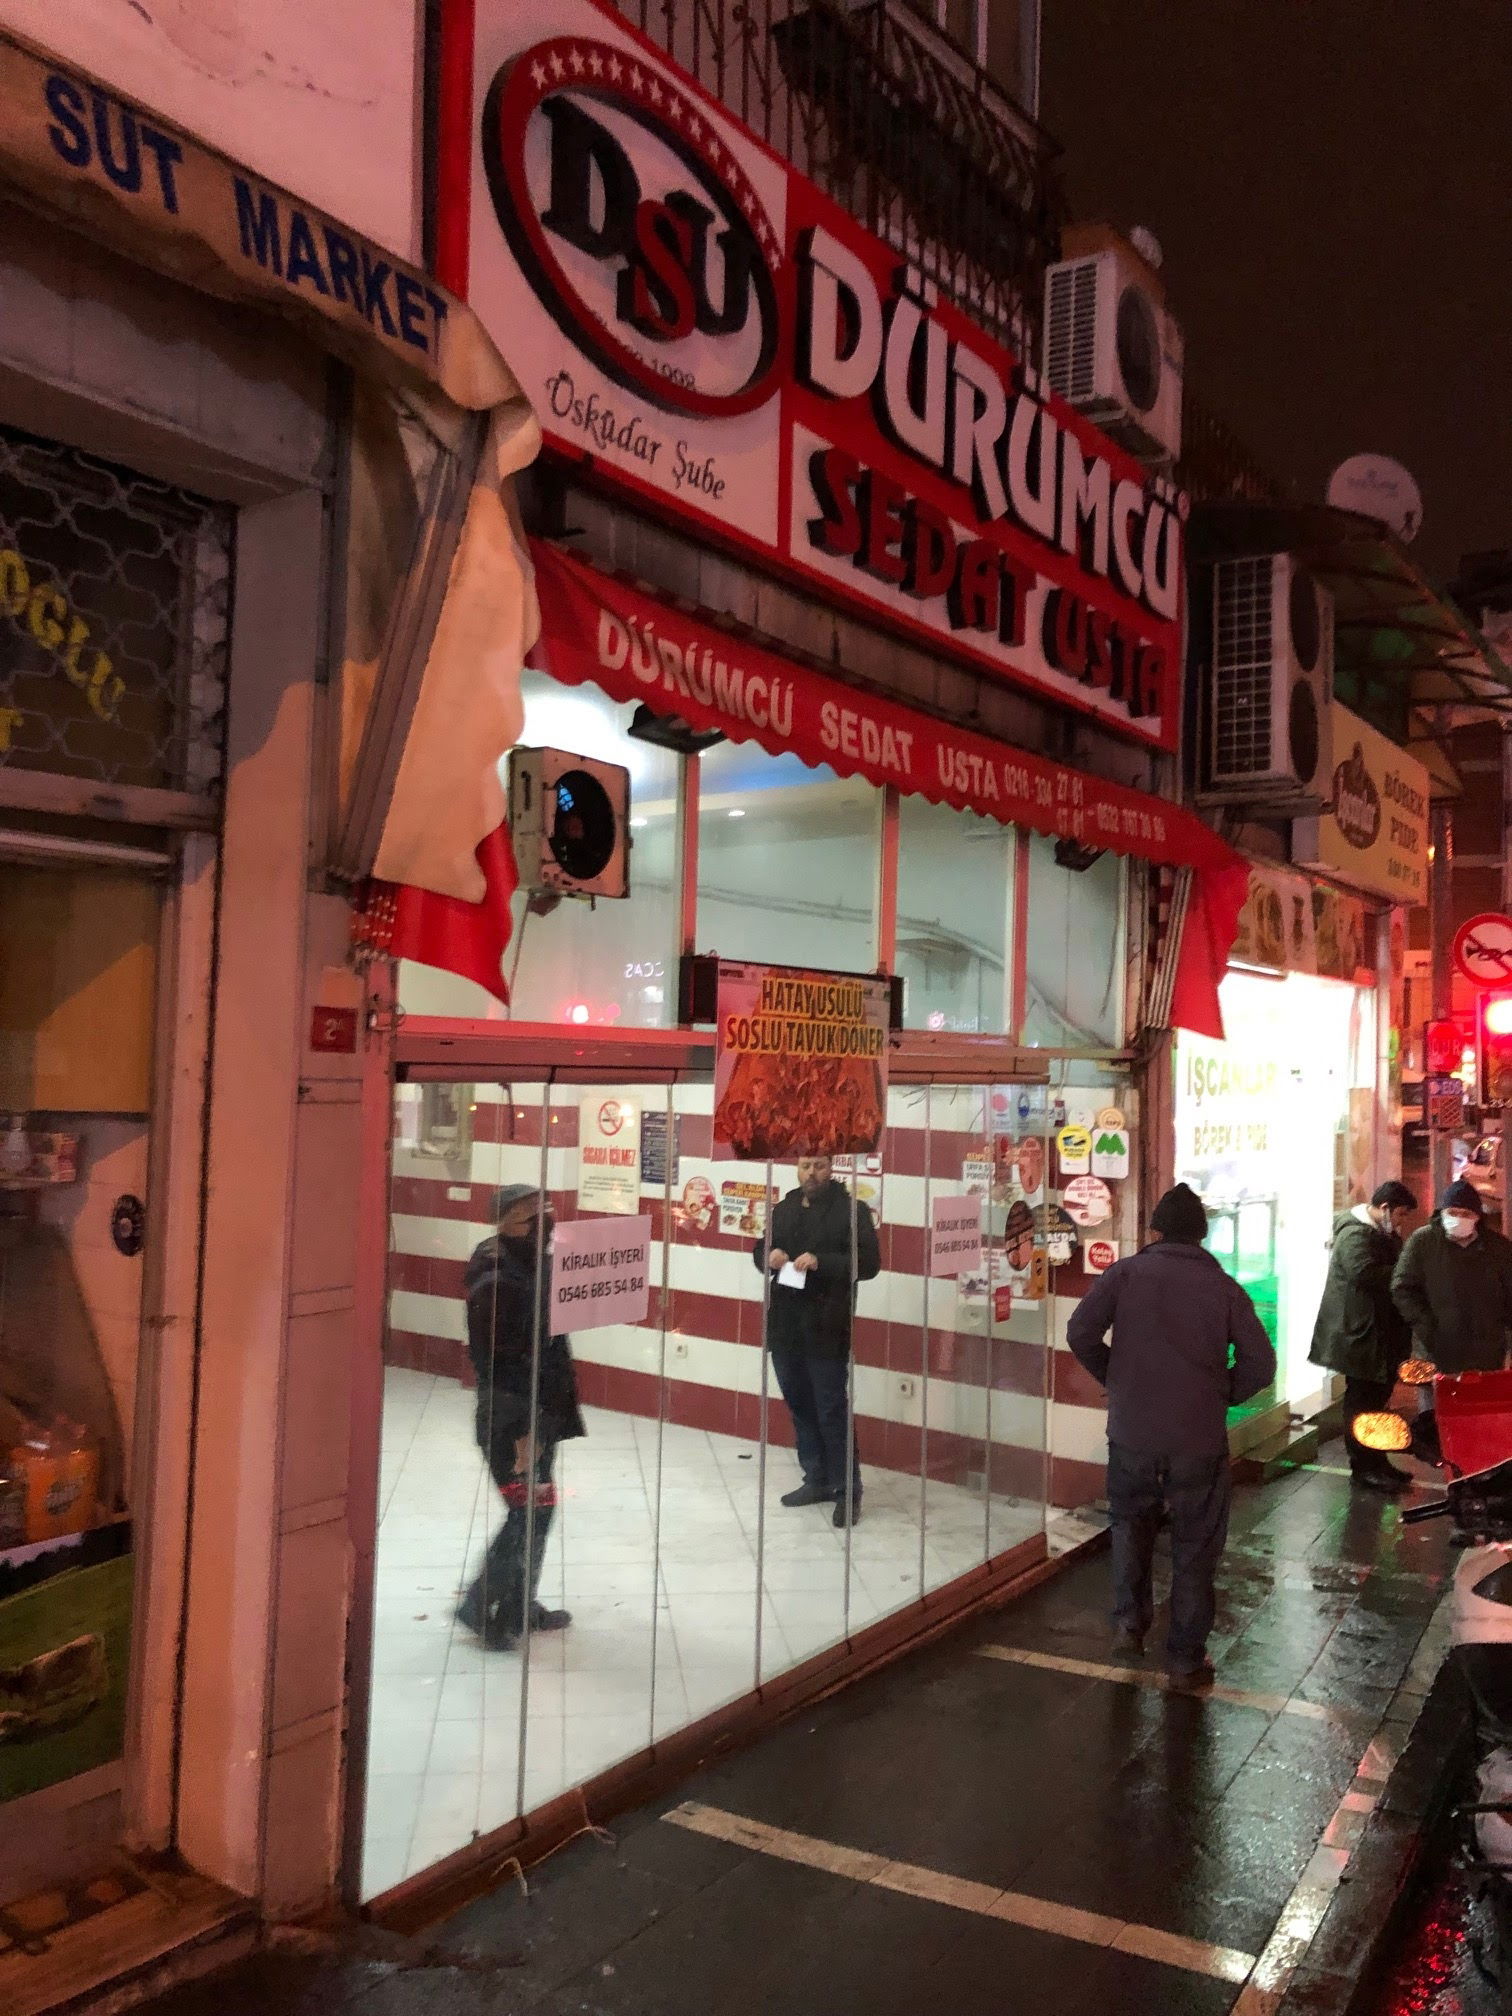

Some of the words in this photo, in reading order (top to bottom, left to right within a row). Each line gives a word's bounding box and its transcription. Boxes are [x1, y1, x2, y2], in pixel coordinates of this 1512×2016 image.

[234, 176, 448, 365] MARKET
[806, 225, 1180, 622] DÜRÜMCÜ
[672, 439, 726, 500] Şube
[808, 447, 1037, 648] SEDAT
[1046, 585, 1166, 719] USTA
[599, 606, 793, 738] DÜRÜMCÜ
[820, 701, 914, 776] SEDAT
[938, 743, 1000, 802] USTA
[761, 978, 814, 1017] HATAY
[817, 982, 863, 1018] USULÜ
[726, 1017, 782, 1050] SOSLU
[786, 1020, 836, 1052] TAVUK
[840, 1020, 885, 1056] DÖNER
[562, 1252, 607, 1272] KİRALIK
[609, 1244, 644, 1268] İŞYERİ
[558, 1285, 588, 1304] 0546
[590, 1281, 612, 1298] 685
[614, 1278, 628, 1295] 54
[630, 1276, 645, 1292] 84
